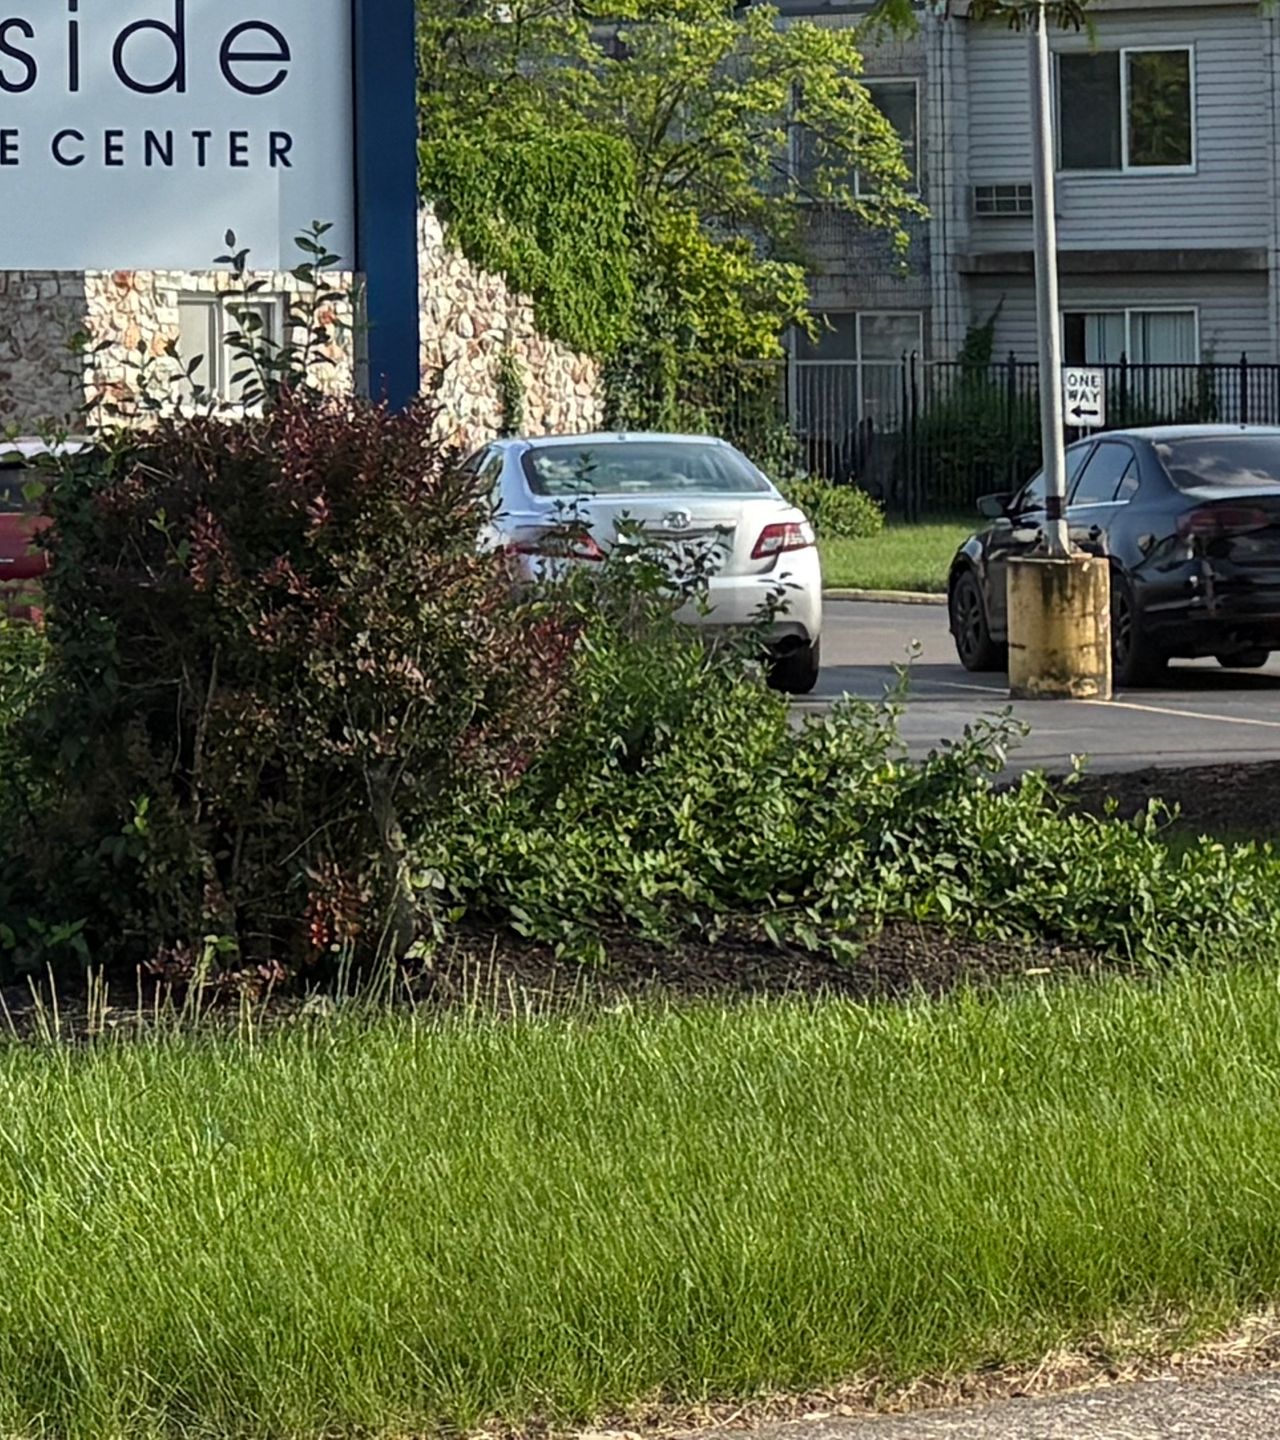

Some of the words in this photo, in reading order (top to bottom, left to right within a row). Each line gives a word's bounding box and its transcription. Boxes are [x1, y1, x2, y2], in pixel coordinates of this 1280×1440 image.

[51, 129, 295, 169] CENTER
[1068, 374, 1100, 388] ONE
[1068, 390, 1100, 403] WAY
